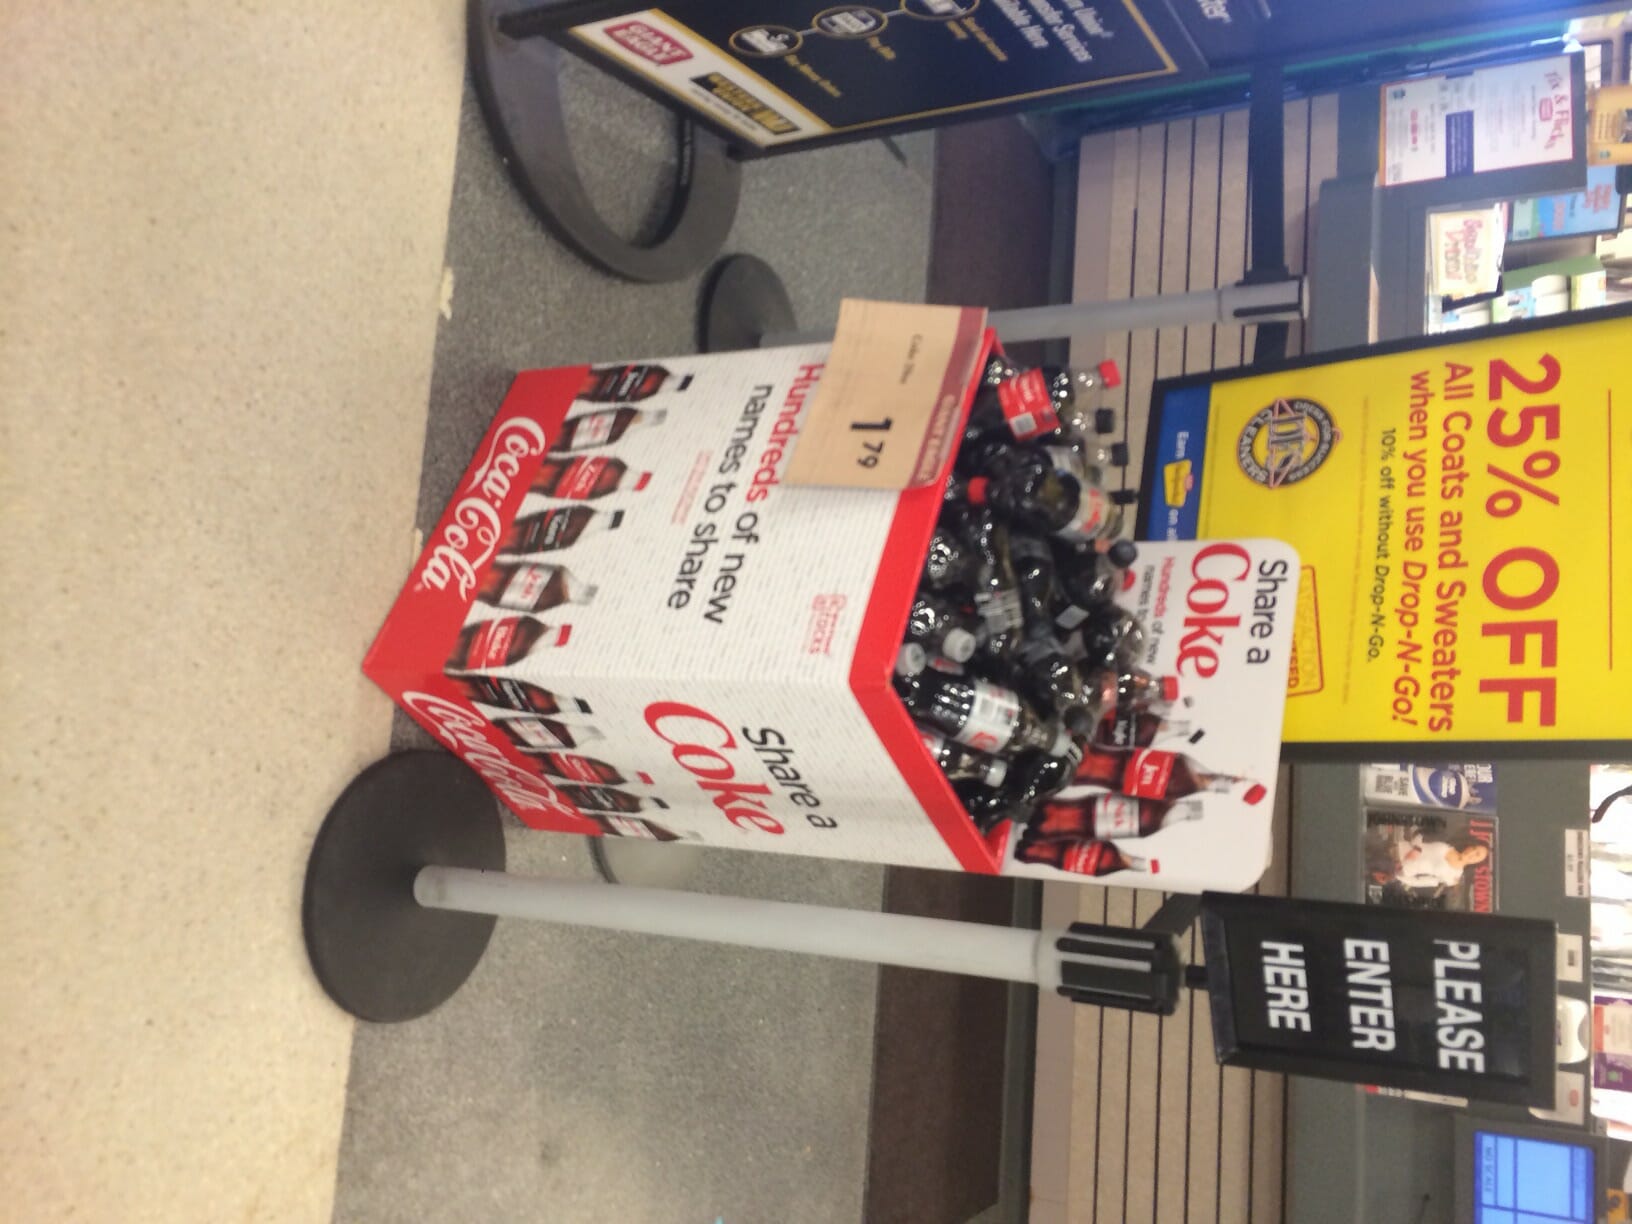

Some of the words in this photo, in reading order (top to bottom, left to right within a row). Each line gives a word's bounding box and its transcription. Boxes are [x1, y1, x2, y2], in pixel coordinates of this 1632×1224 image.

[1408, 370, 1434, 440] when
[1443, 362, 1473, 400] All
[717, 384, 776, 474] names
[745, 362, 827, 503] Hundreds
[1175, 431, 1190, 459] Earn
[1238, 407, 1272, 484] CLEANERS
[1380, 428, 1396, 461] 10%
[1440, 411, 1472, 500] Coats
[1485, 353, 1561, 518] 25%
[419, 416, 546, 602] Coca-Cola
[703, 482, 737, 513] to
[1379, 467, 1395, 490] off
[1402, 449, 1430, 497] you
[666, 523, 720, 610] share
[731, 512, 760, 544] of
[1375, 496, 1394, 559] without
[1403, 507, 1426, 552] use
[1437, 511, 1468, 569] and
[702, 553, 748, 625] new
[1139, 564, 1156, 605] names
[1152, 556, 1176, 618] Hundreds
[1176, 543, 1251, 679] Coke
[1250, 559, 1289, 639] Share
[1366, 565, 1390, 663] Drop-N-Go.
[1144, 637, 1164, 665] new
[1151, 621, 1169, 635] of
[1246, 647, 1271, 665] a
[1391, 561, 1427, 726] Drop-N-Go!
[1428, 581, 1466, 732] Sweaters
[1479, 546, 1559, 727] OFF
[643, 701, 786, 836] Coke
[740, 726, 822, 807] Share
[805, 813, 839, 830] a
[1469, 829, 1493, 913] JSTOWN
[1261, 940, 1311, 1033] HERE
[1343, 938, 1396, 1052] ENTER
[1433, 939, 1485, 1074] PLEASE
